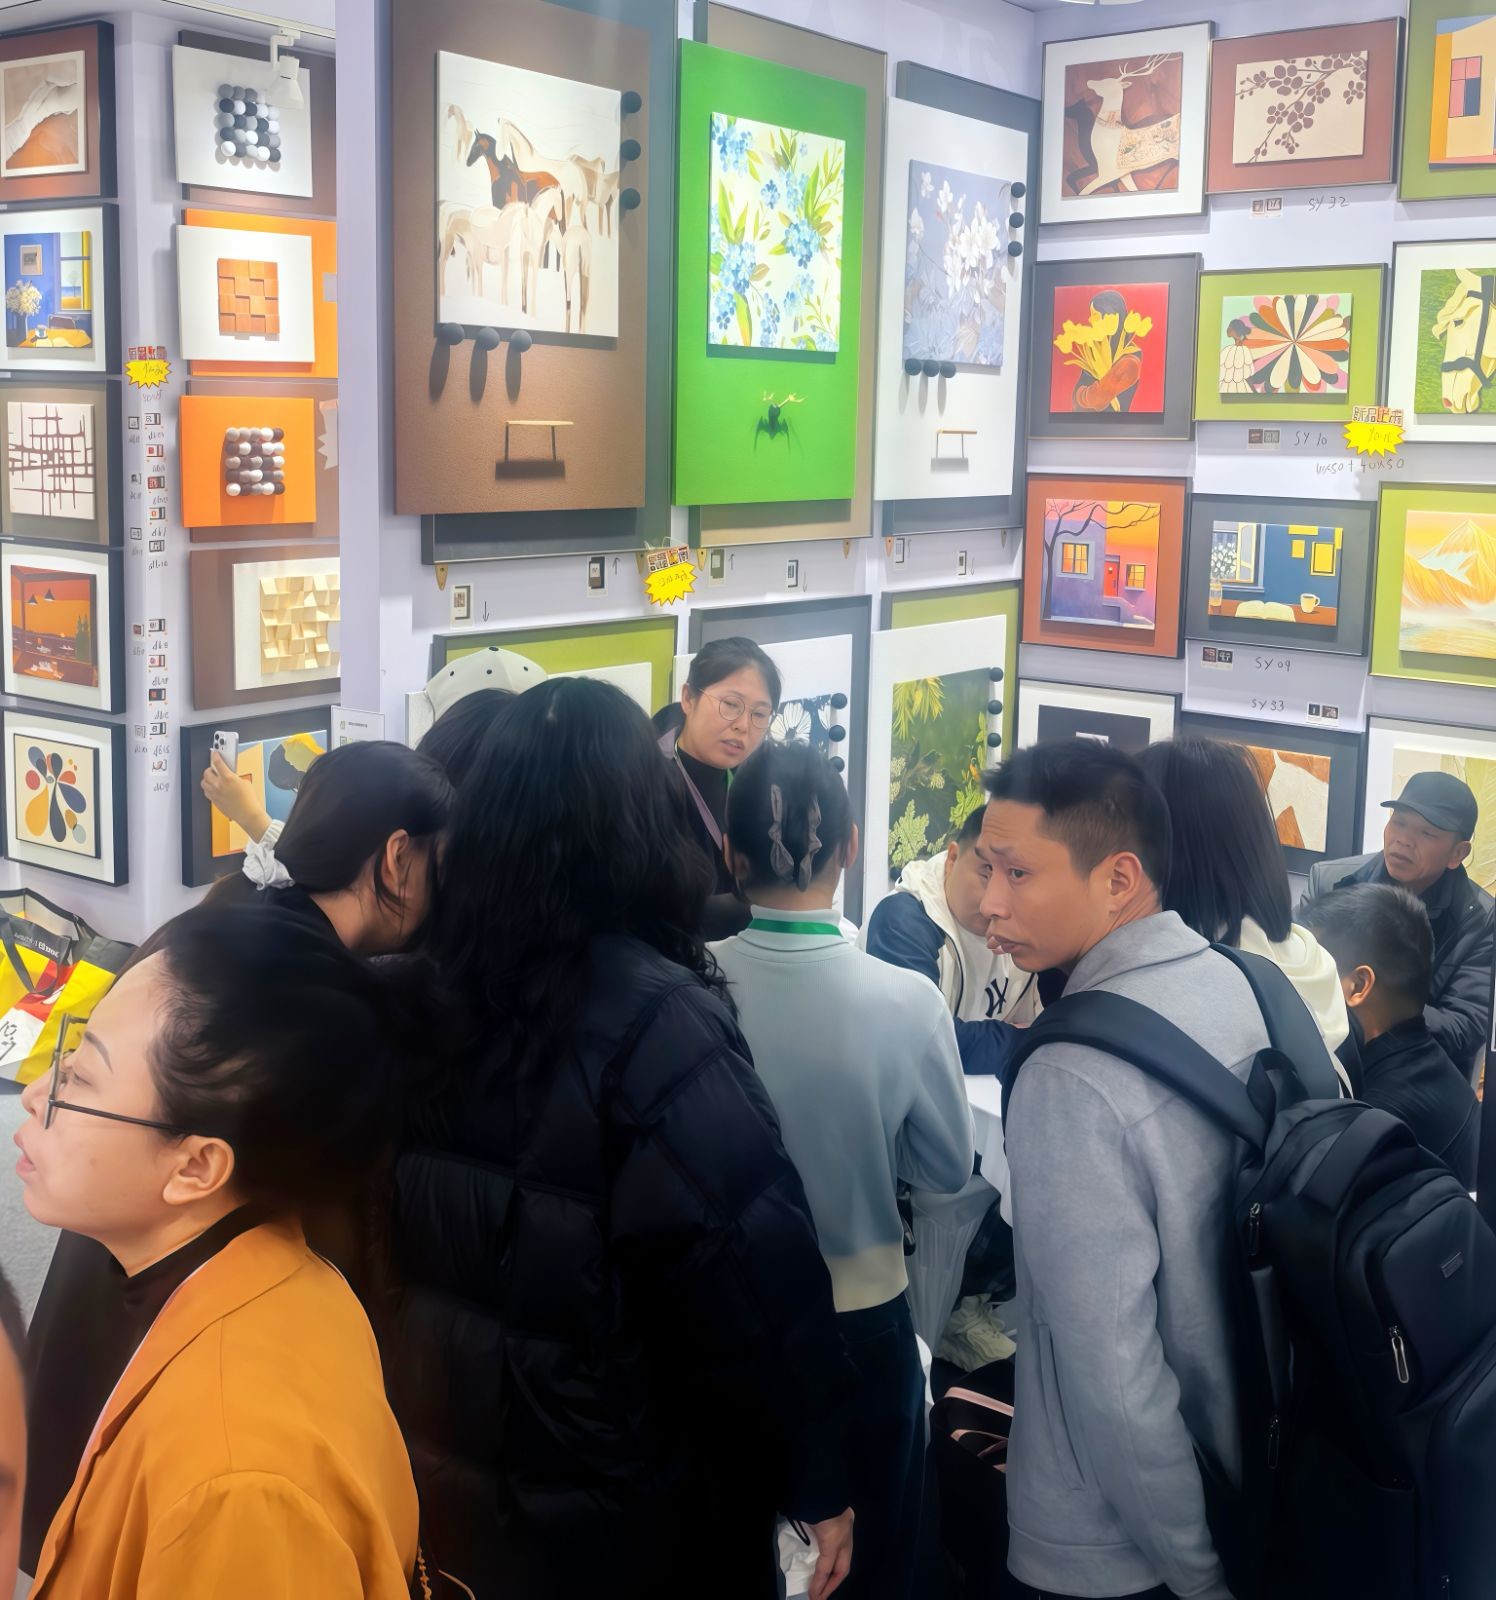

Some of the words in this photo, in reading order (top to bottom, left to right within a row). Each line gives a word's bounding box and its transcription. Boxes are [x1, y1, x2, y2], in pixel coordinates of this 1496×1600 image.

[1308, 195, 1325, 212] SY
[1328, 196, 1349, 210] 32
[1294, 431, 1310, 447] SY
[1316, 432, 1328, 447] 10
[1255, 656, 1274, 671] SY
[1277, 659, 1291, 672] 09
[1251, 698, 1268, 712] SY
[984, 976, 1009, 1019] NY
